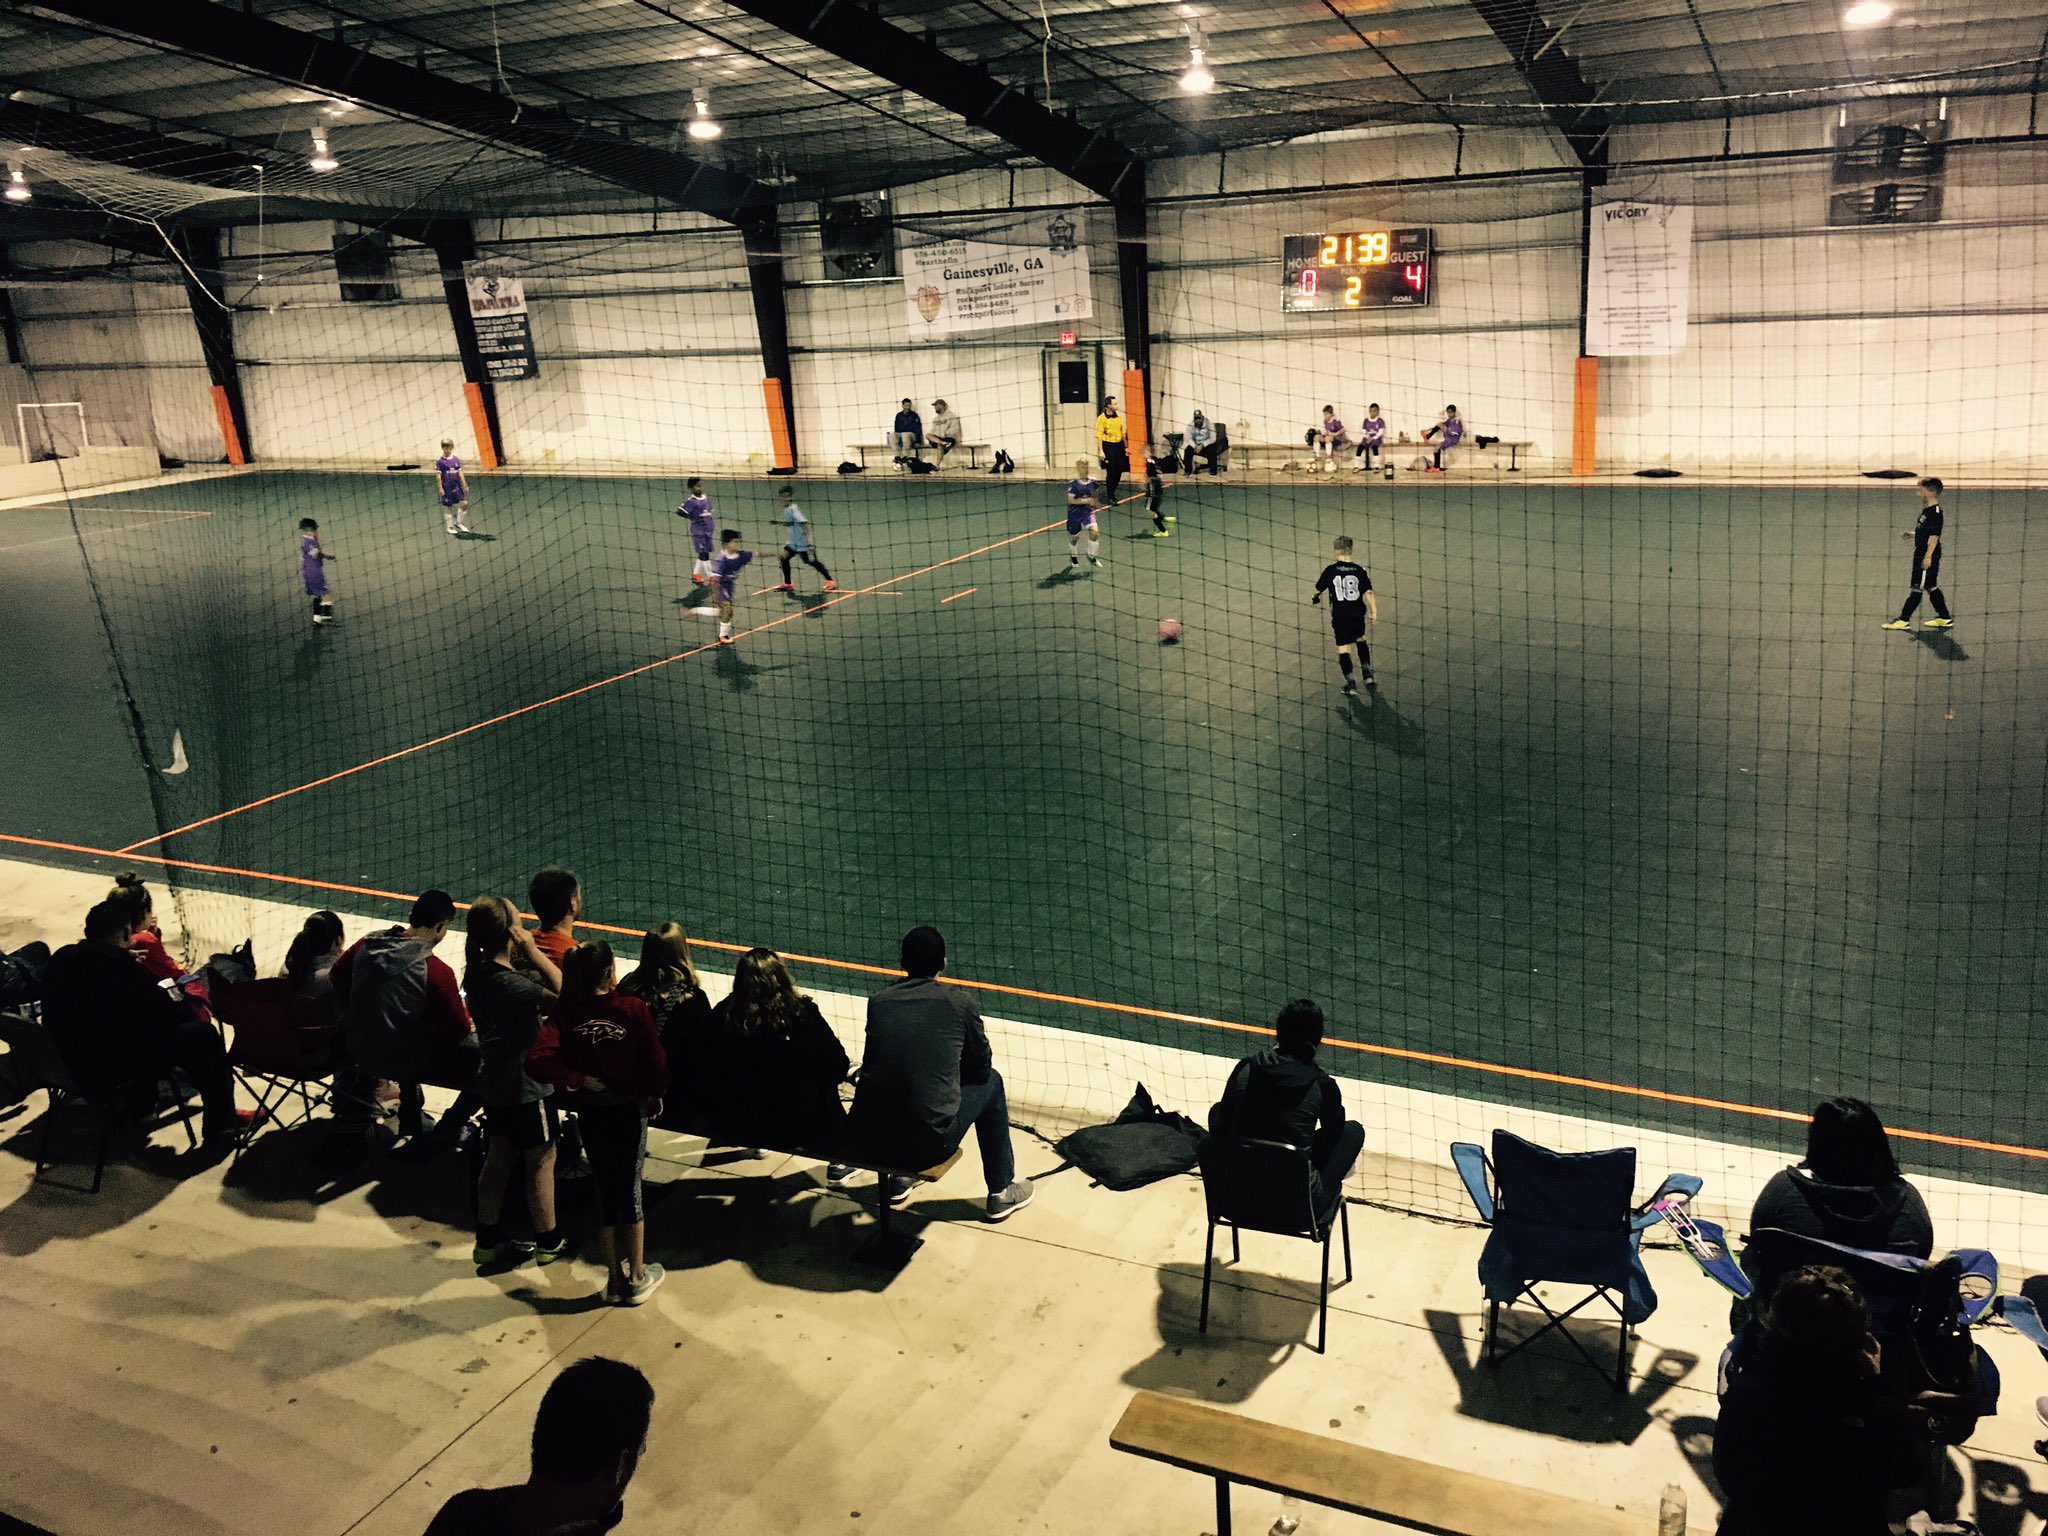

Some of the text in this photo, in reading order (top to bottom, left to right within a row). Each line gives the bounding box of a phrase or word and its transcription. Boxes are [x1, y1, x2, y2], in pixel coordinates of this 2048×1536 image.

[943, 257, 1044, 281] Gainesville, GA
[1287, 256, 1317, 269] HOME
[1390, 250, 1426, 264] GUEST
[1019, 279, 1045, 287] Soccer
[1301, 269, 1317, 297] 0
[1405, 265, 1423, 290] 4
[956, 289, 1030, 303] rockportsoccer.com
[1344, 276, 1362, 306] 2
[1332, 574, 1361, 602] 18
